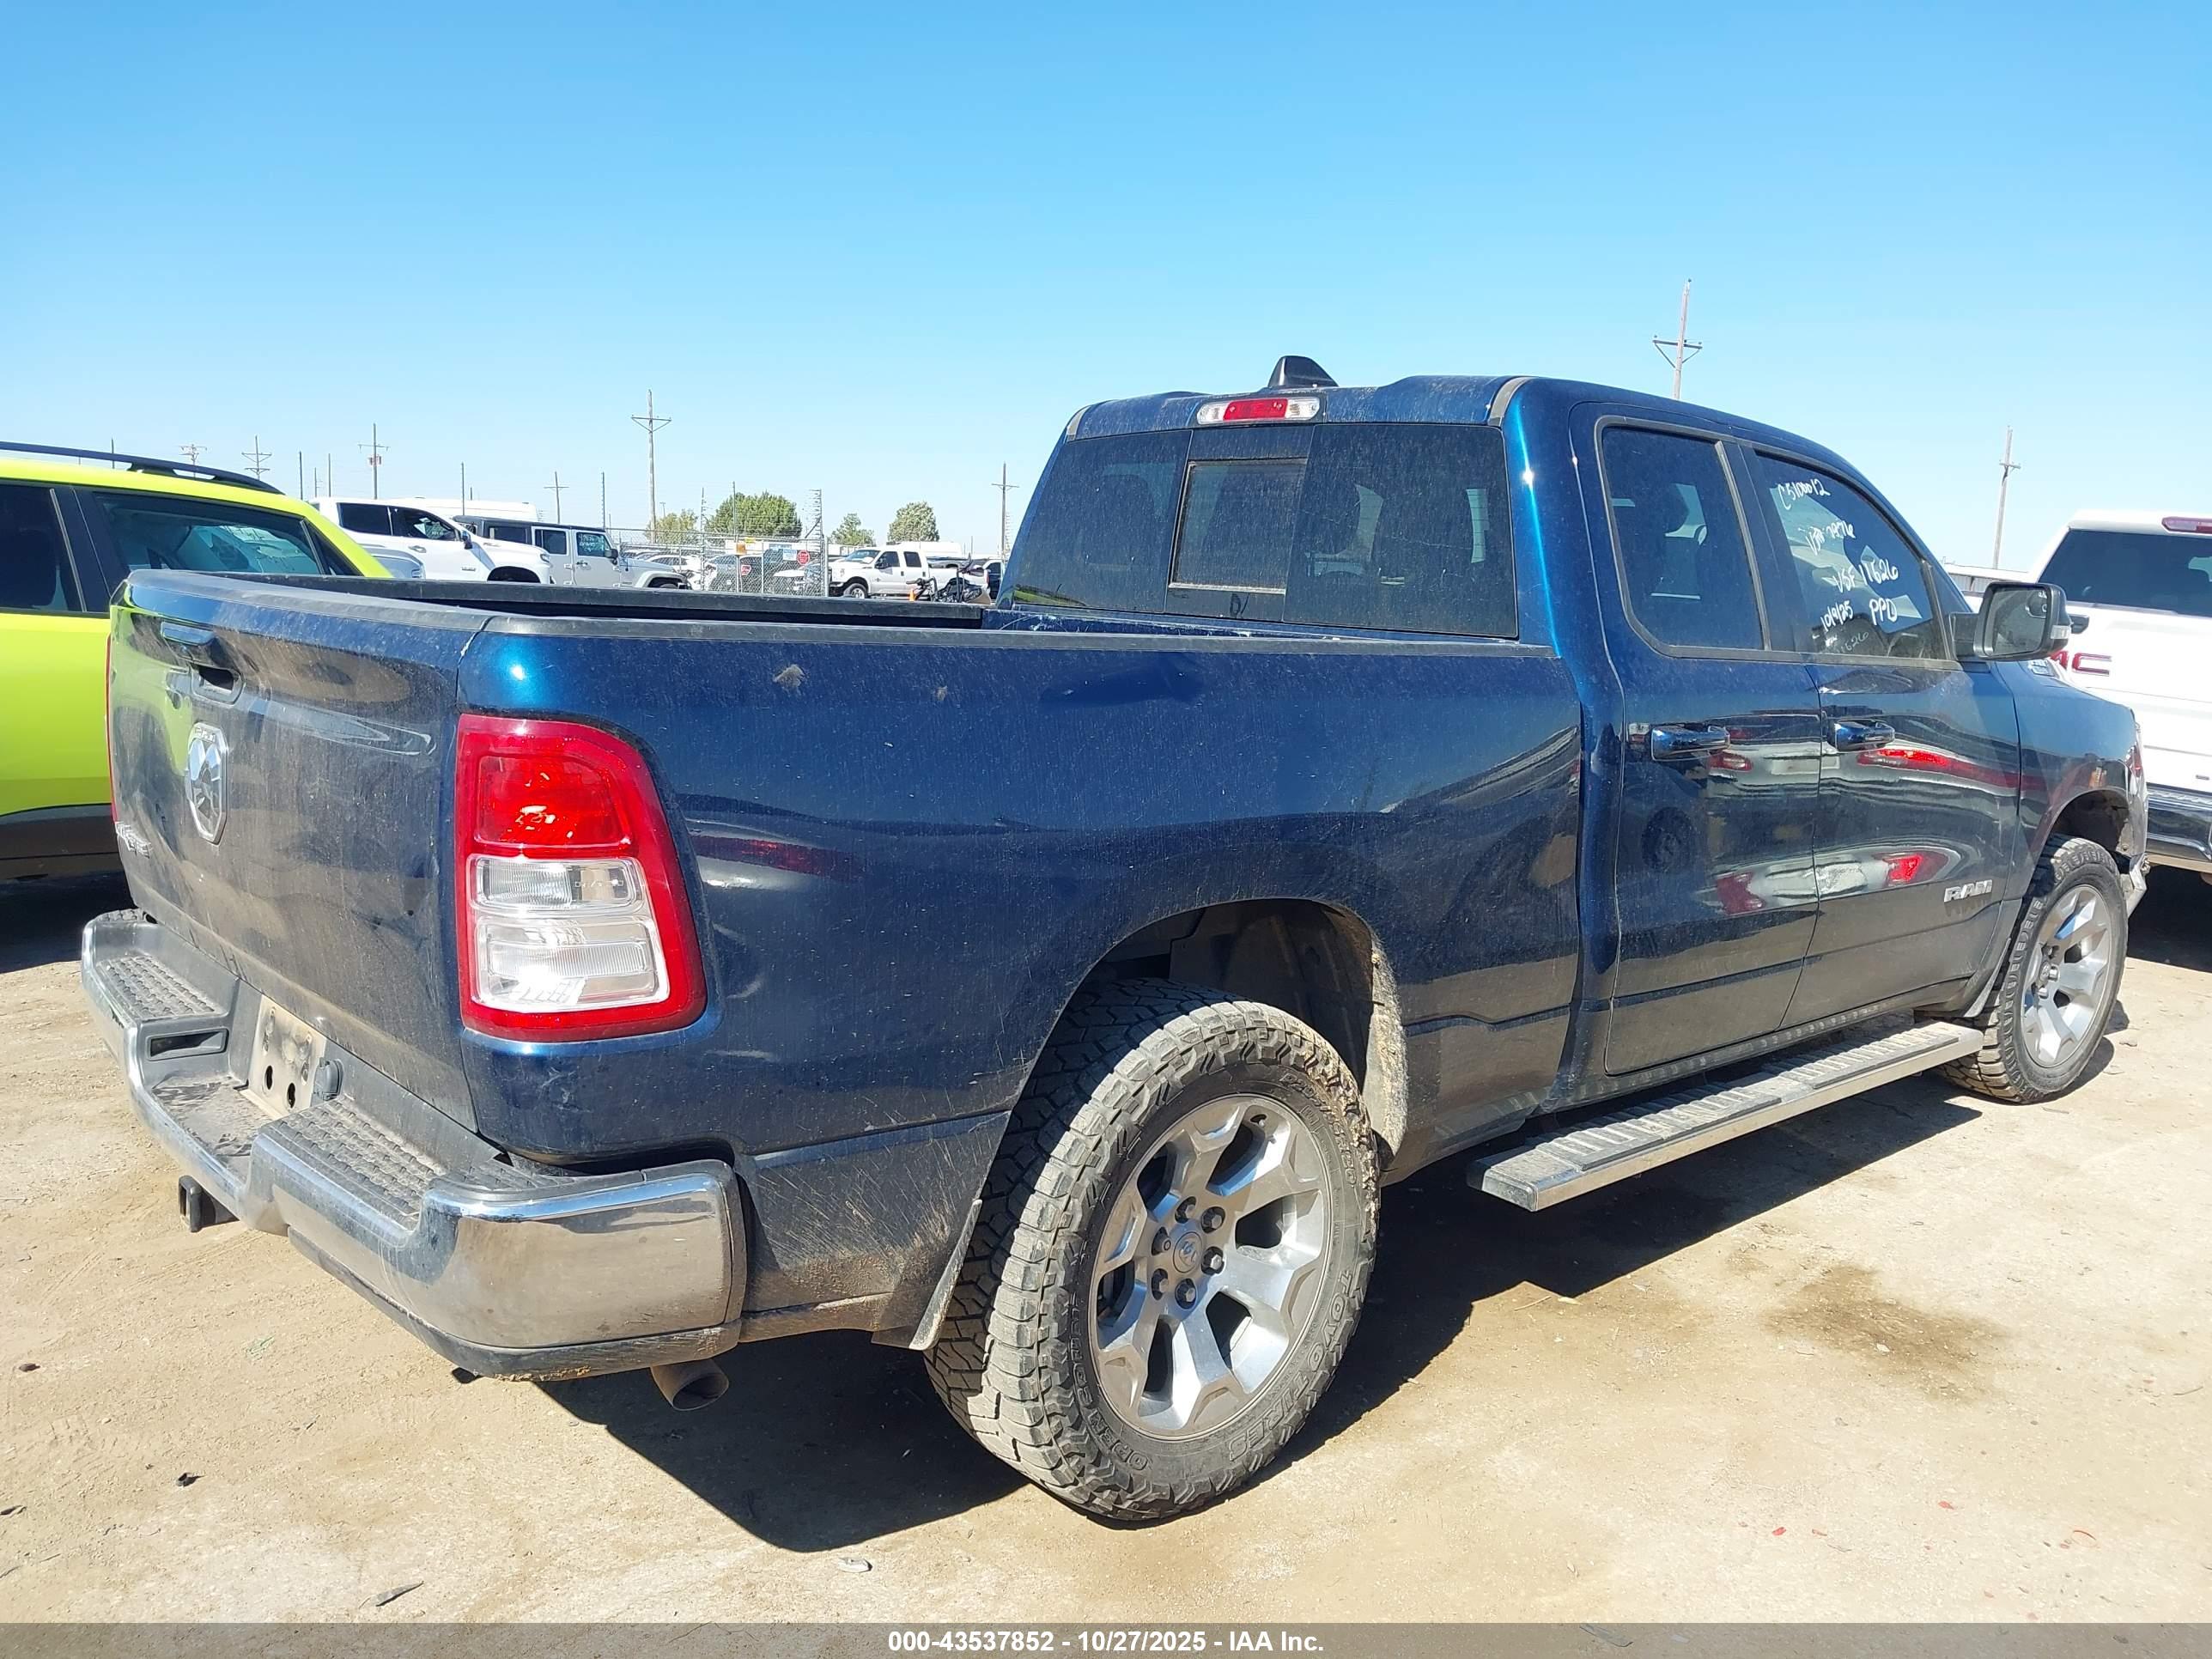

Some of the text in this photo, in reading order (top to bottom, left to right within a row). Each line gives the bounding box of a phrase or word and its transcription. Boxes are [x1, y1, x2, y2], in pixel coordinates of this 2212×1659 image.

[1943, 878, 1993, 903] RAM
[1229, 1269, 1353, 1462] TOYO TIRES
